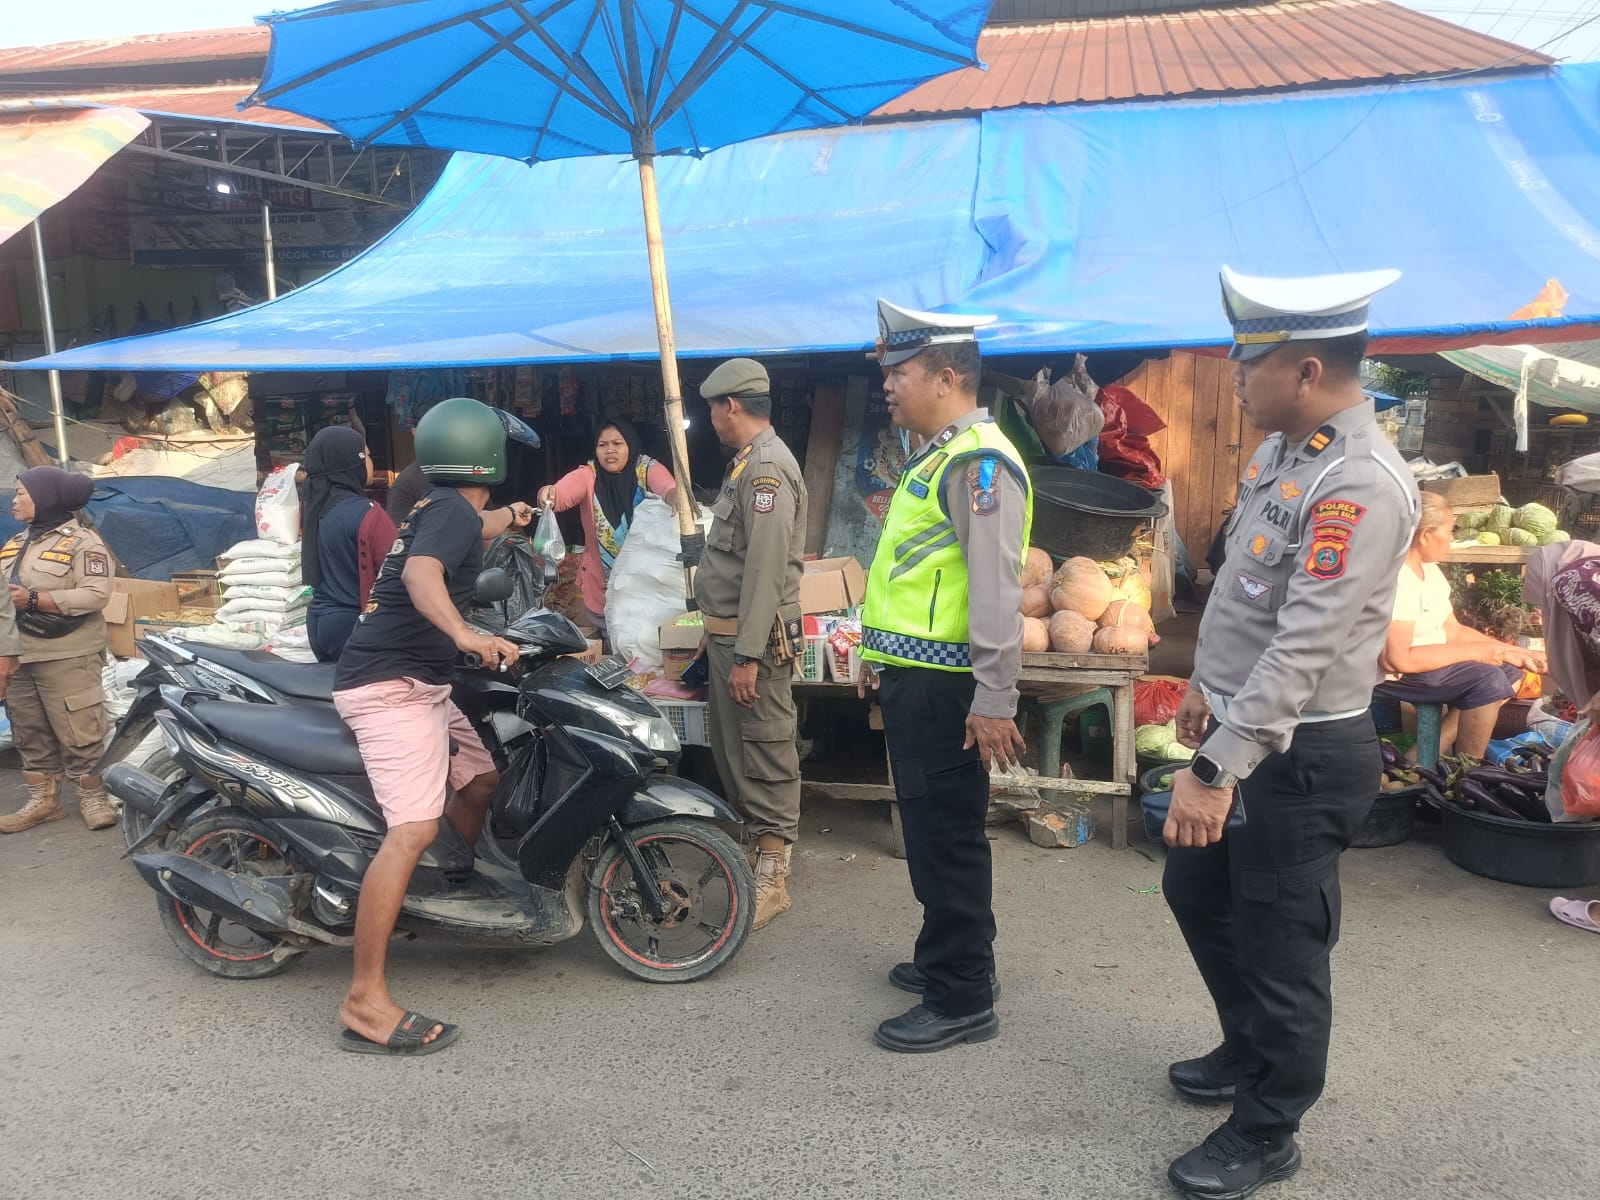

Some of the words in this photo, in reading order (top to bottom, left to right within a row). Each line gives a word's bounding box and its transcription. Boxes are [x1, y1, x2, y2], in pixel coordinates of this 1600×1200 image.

[278, 250, 310, 260] UCOK
[1319, 503, 1357, 514] POLRES
[1260, 500, 1292, 530] POLRI
